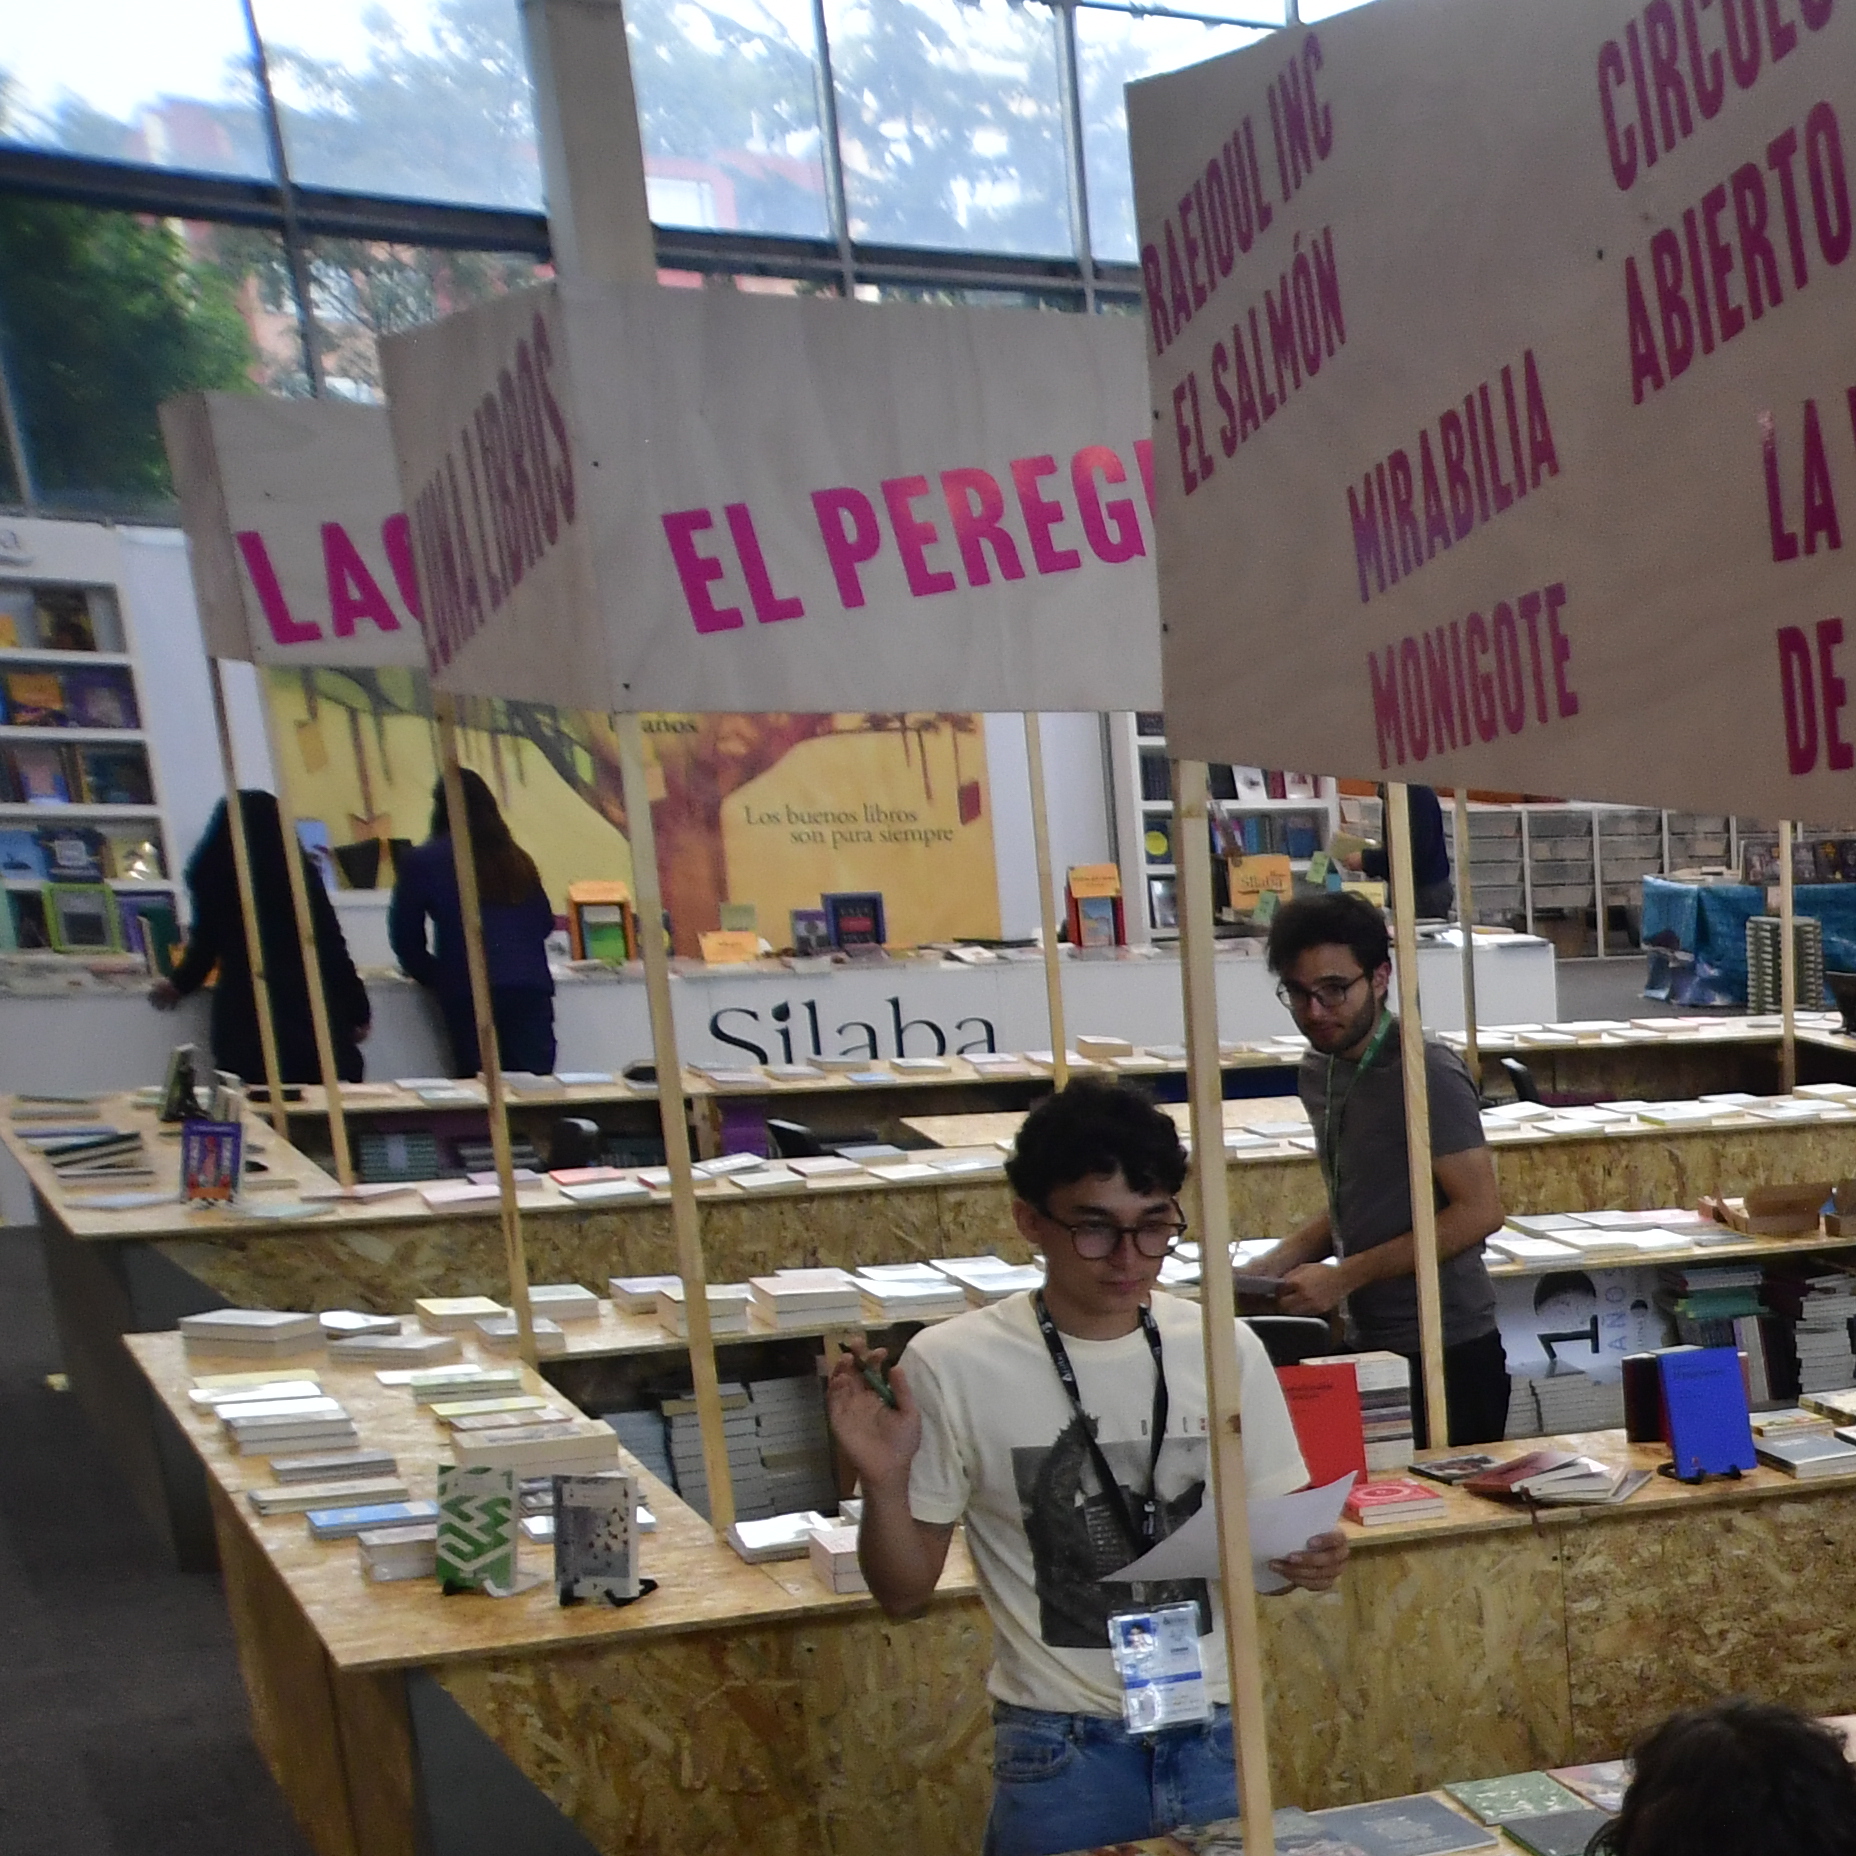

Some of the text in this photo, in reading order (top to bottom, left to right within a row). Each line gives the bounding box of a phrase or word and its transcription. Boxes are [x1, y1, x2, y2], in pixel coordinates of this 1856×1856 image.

[1266, 32, 1335, 204] INC
[1599, 0, 1833, 194] CIRCU
[1623, 100, 1854, 407] ABIERTO
[1172, 225, 1347, 497] EL SALMÓN
[661, 438, 1155, 636] EL PEREG
[1348, 348, 1560, 604] MIRABILIA
[1759, 400, 1842, 564] LA
[1368, 581, 1581, 772] MONIGOTE
[1777, 616, 1854, 776] DE
[745, 804, 917, 827] Los buenos libros
[790, 825, 954, 849] son para siempre
